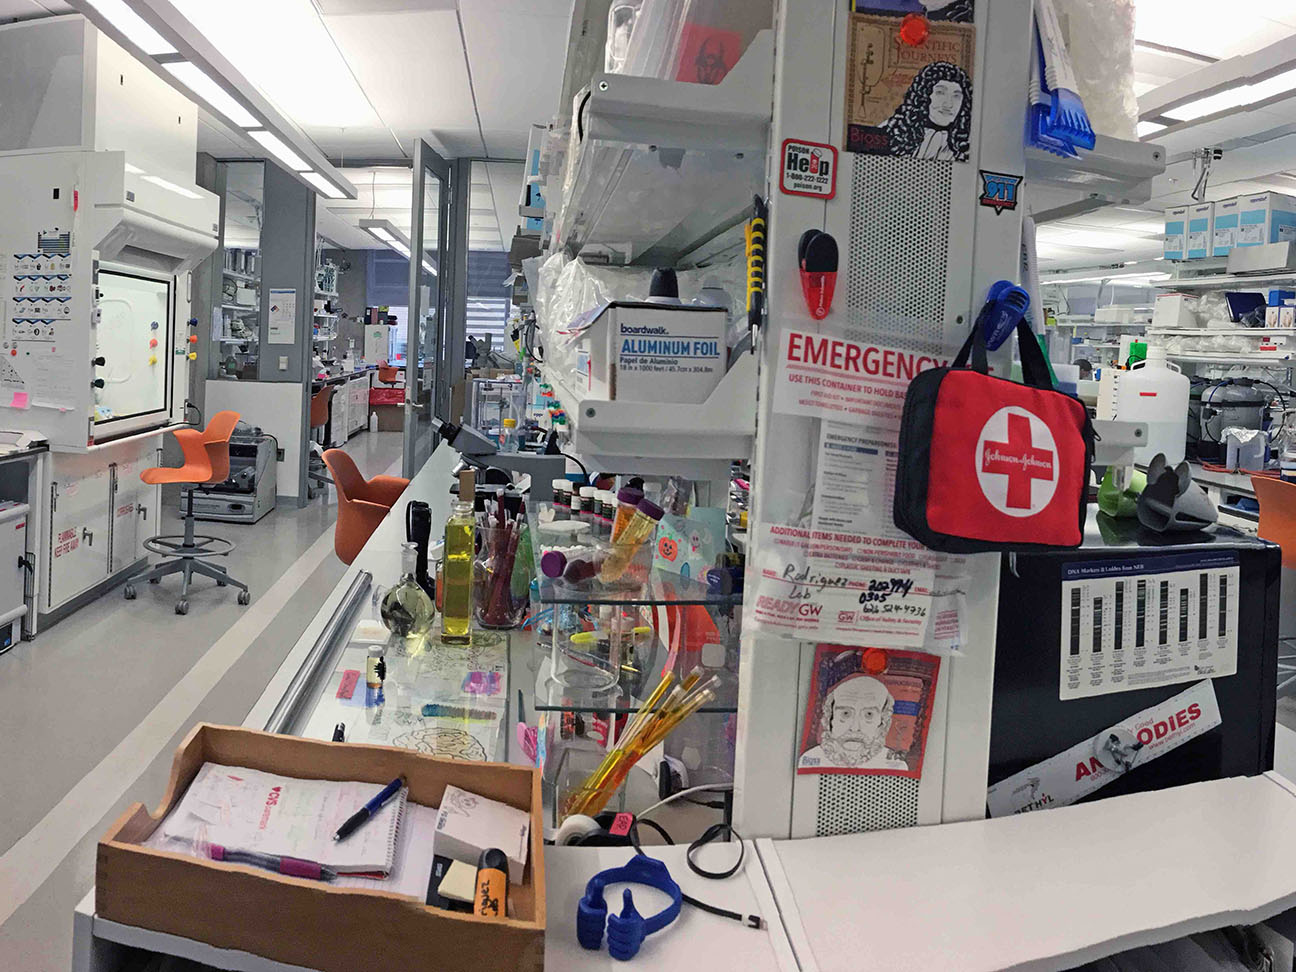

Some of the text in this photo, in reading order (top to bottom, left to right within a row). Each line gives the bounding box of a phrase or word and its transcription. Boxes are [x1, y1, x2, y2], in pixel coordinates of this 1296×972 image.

[986, 182, 1014, 200] 911
[622, 338, 720, 356] ALUMINUM FOIL
[789, 374, 802, 384] USE
[804, 376, 820, 386] THIS
[822, 379, 862, 392] CONTAINER
[864, 386, 873, 394] TO
[874, 388, 894, 398] HOLD
[770, 526, 811, 539] ADDITIONAL
[812, 531, 833, 541] ITEMS
[834, 532, 862, 544] NEEDED
[864, 536, 872, 545] TO
[872, 538, 906, 548] COMPLETE
[783, 564, 848, 592] Rodriguez
